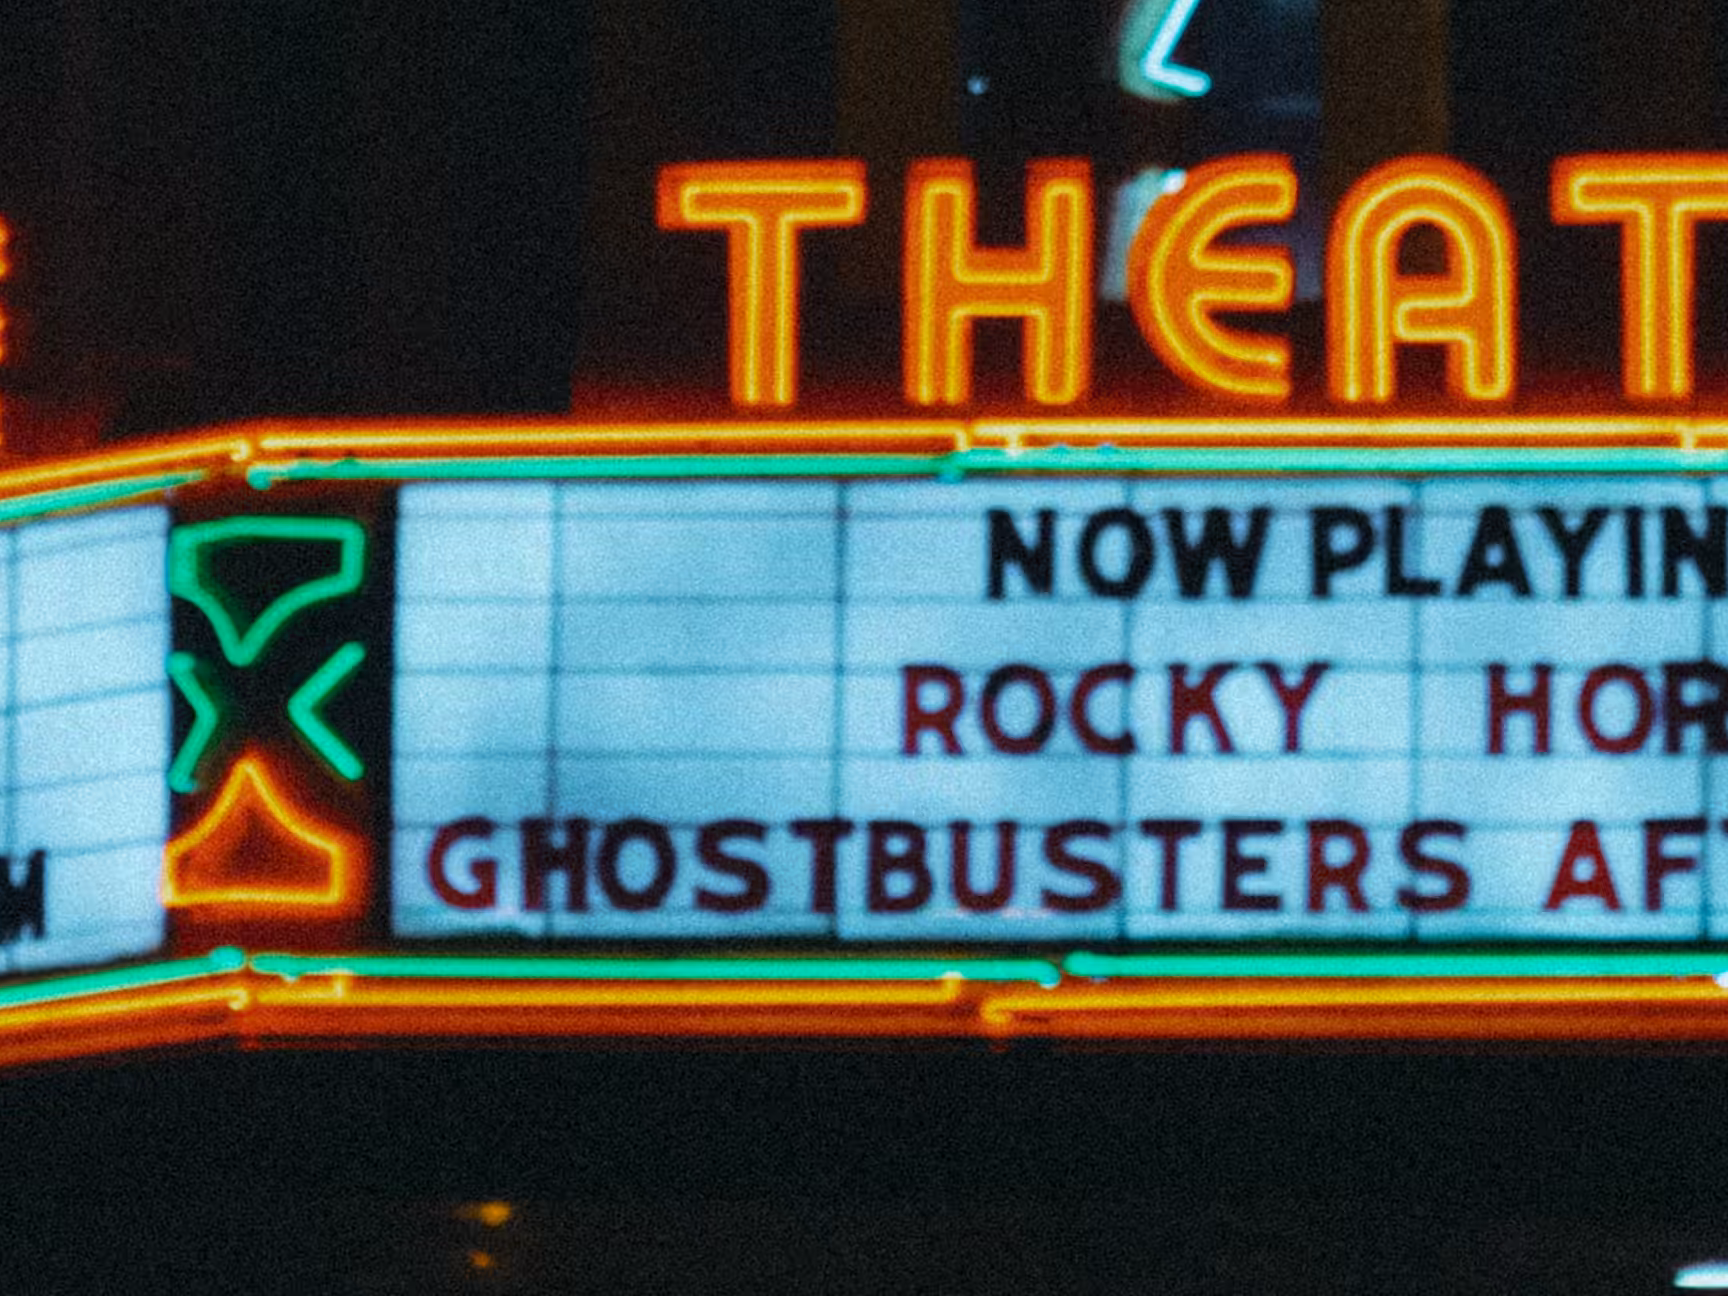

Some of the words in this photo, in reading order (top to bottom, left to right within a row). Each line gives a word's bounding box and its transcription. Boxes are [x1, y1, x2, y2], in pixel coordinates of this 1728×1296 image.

[984, 504, 1274, 601] NOW
[899, 659, 1332, 758] ROCKY
[424, 816, 1473, 916] GHOSTBUSTERS
